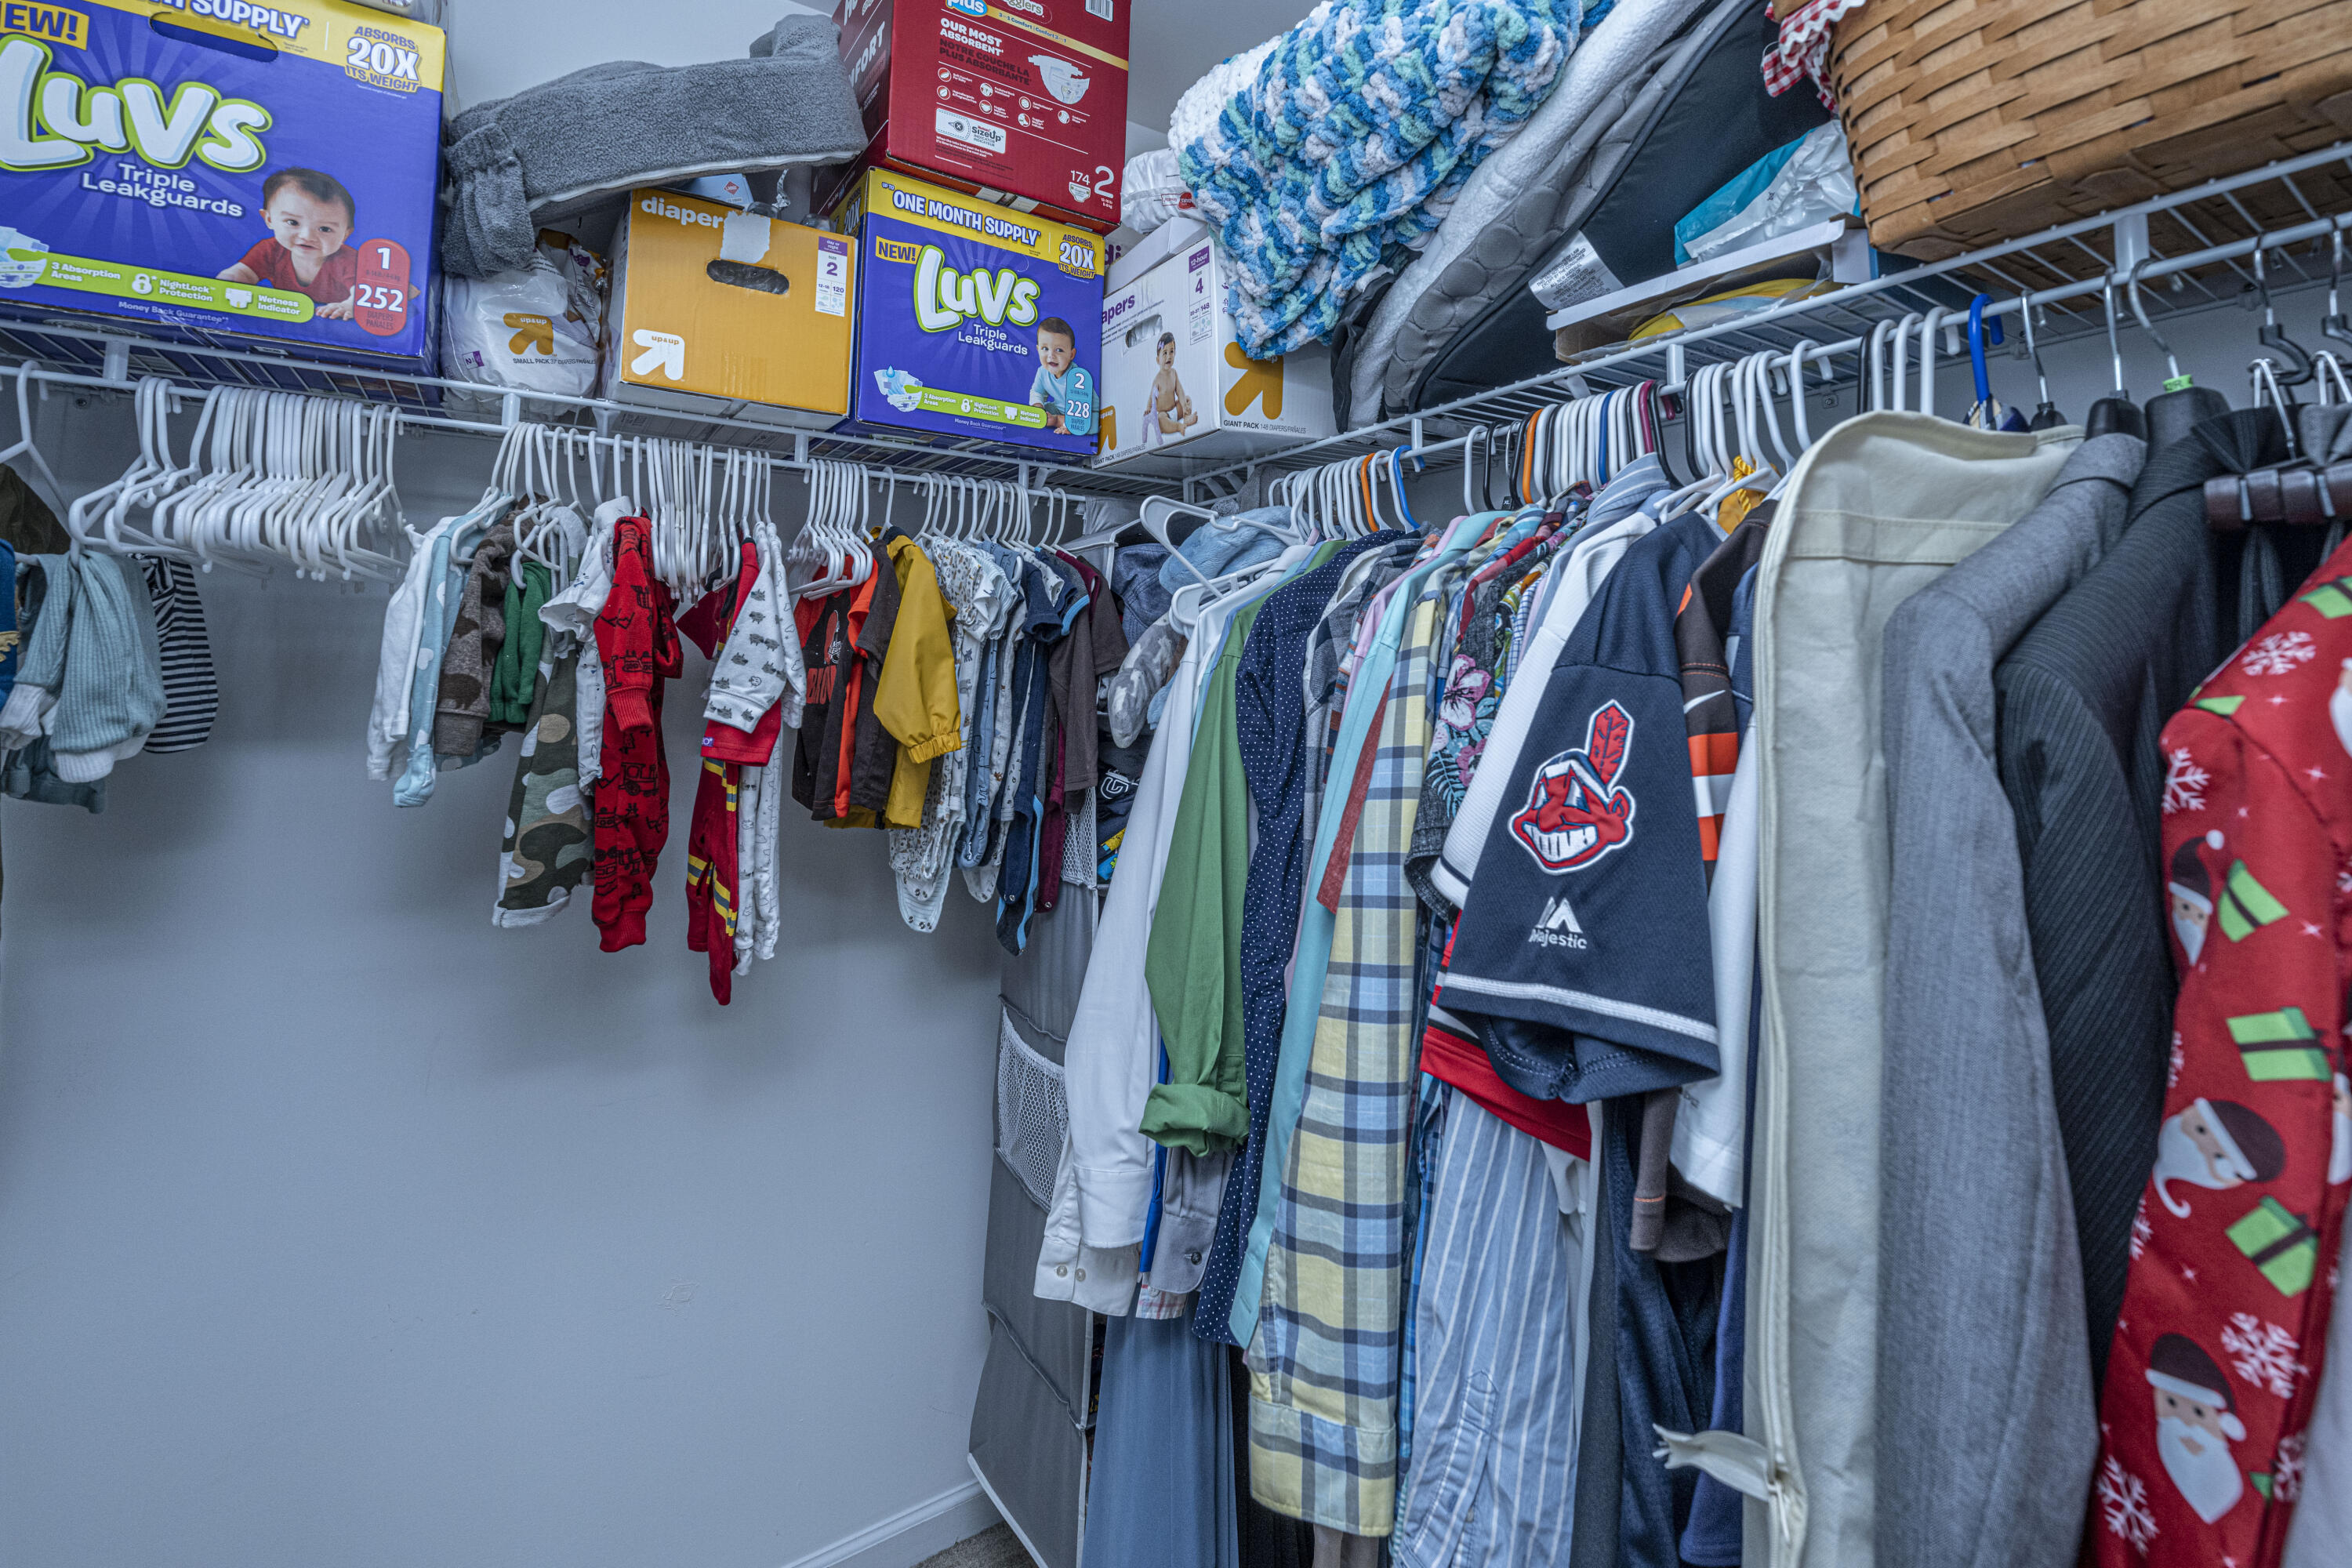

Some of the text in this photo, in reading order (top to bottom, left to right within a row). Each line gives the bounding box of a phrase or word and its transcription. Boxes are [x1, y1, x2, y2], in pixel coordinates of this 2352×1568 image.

[4, 2, 78, 41] EW!
[354, 26, 416, 50] ABSORBS
[941, 17, 1003, 48] OUR MOST
[347, 36, 419, 82] 20X
[849, 21, 885, 88] FORT
[939, 48, 964, 63] PLUS
[939, 39, 1029, 77] NOTRE COUCHE LA
[346, 66, 366, 80] ITS
[369, 73, 419, 92] WEIGHT
[0, 37, 270, 170] Luvs
[974, 134, 995, 143] INDICATOR
[974, 137, 995, 147] INDICATEUR
[119, 163, 194, 193] Triple
[1071, 170, 1090, 185] 174
[1094, 165, 1114, 198] 2
[82, 172, 243, 217] Leakguards
[641, 197, 727, 228] diaper
[893, 190, 926, 215] ONE
[928, 200, 982, 231] MONTH
[1062, 234, 1093, 249] ABSORBS
[377, 247, 390, 270] 1
[879, 241, 916, 261] NEW!
[1059, 241, 1094, 270] 20X
[1190, 252, 1208, 267] 12-hour
[51, 262, 121, 280] 3 Absorption
[51, 270, 82, 282] Areas
[826, 261, 838, 276] 2
[1059, 262, 1094, 278] ITS WEIGHT
[159, 287, 213, 303] Protection
[916, 246, 1039, 330] Luvs
[1195, 278, 1203, 294] 4
[258, 294, 299, 308] Wetness
[357, 284, 404, 313] 252
[1200, 302, 1210, 311] 148
[118, 301, 150, 314] Money
[151, 306, 174, 316] Back
[258, 303, 300, 316] Indicator
[1102, 295, 1135, 325] apers
[521, 317, 547, 325] up&up
[652, 336, 680, 345] up&up
[973, 324, 1007, 341] Triple
[958, 332, 1028, 355] Leakguards
[1074, 372, 1085, 390] 2
[928, 394, 956, 404] Absorption
[974, 408, 999, 416] Protection
[1066, 400, 1090, 419] 228
[1243, 421, 1259, 430] PACK
[1528, 928, 1587, 949] Majestic
